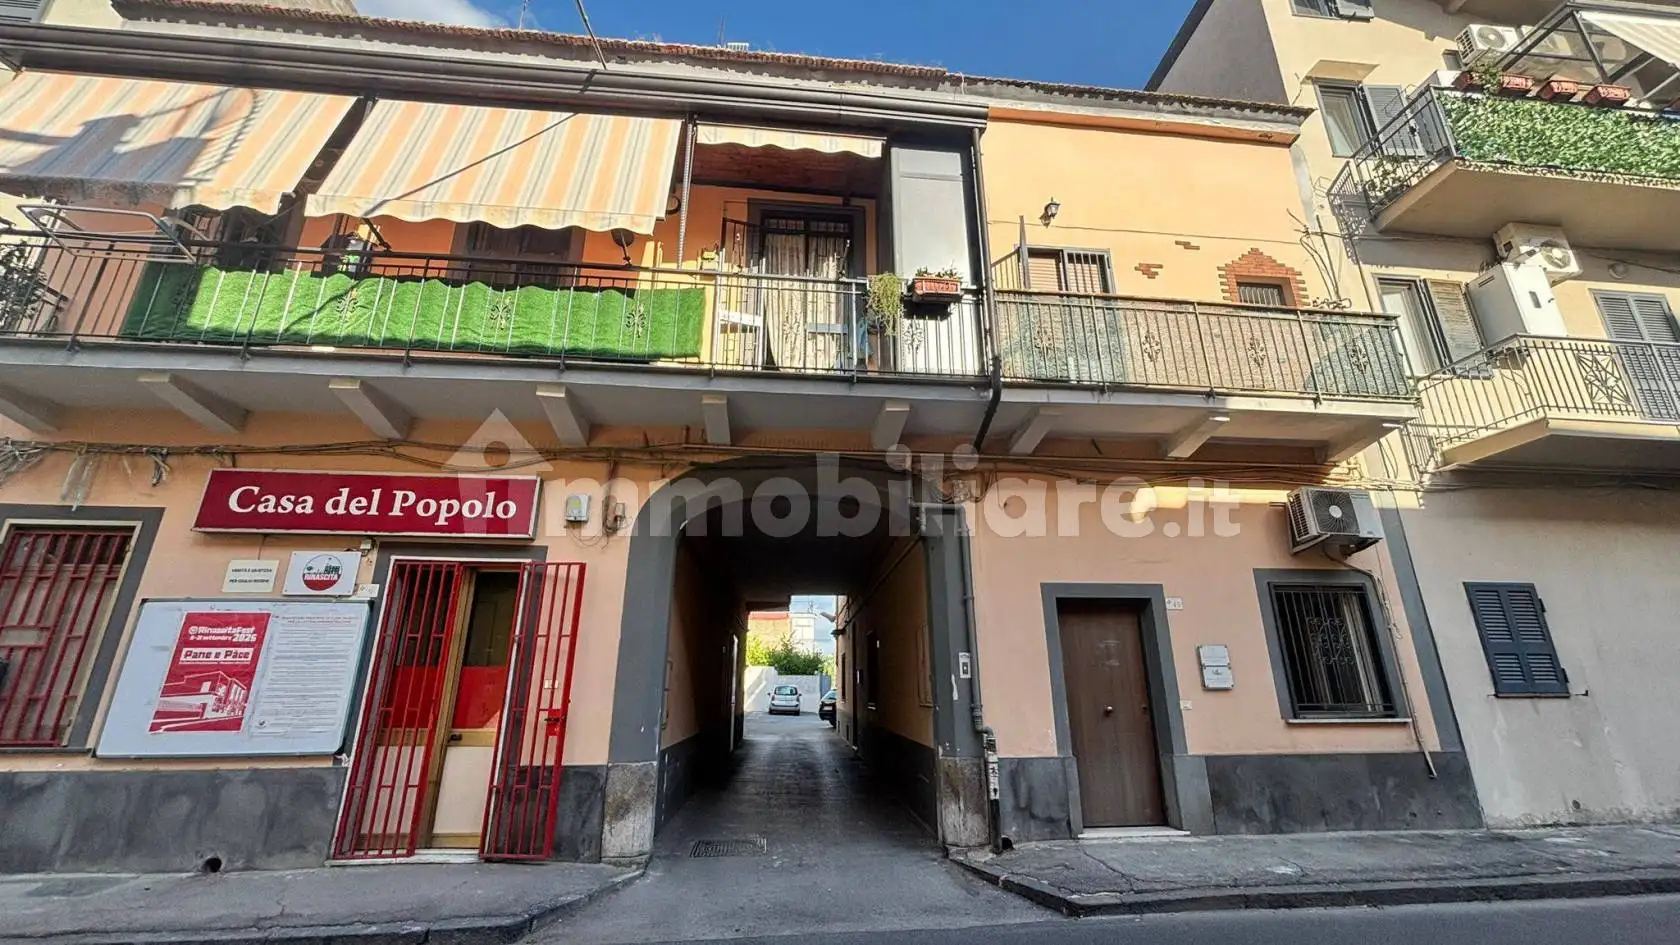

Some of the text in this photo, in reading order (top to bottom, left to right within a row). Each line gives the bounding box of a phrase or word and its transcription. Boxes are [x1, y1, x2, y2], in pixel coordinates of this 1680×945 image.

[228, 486, 517, 525] Casa del Popolo
[304, 573, 338, 581] RINASCITA
[184, 650, 212, 659] Pane
[214, 651, 221, 659] e
